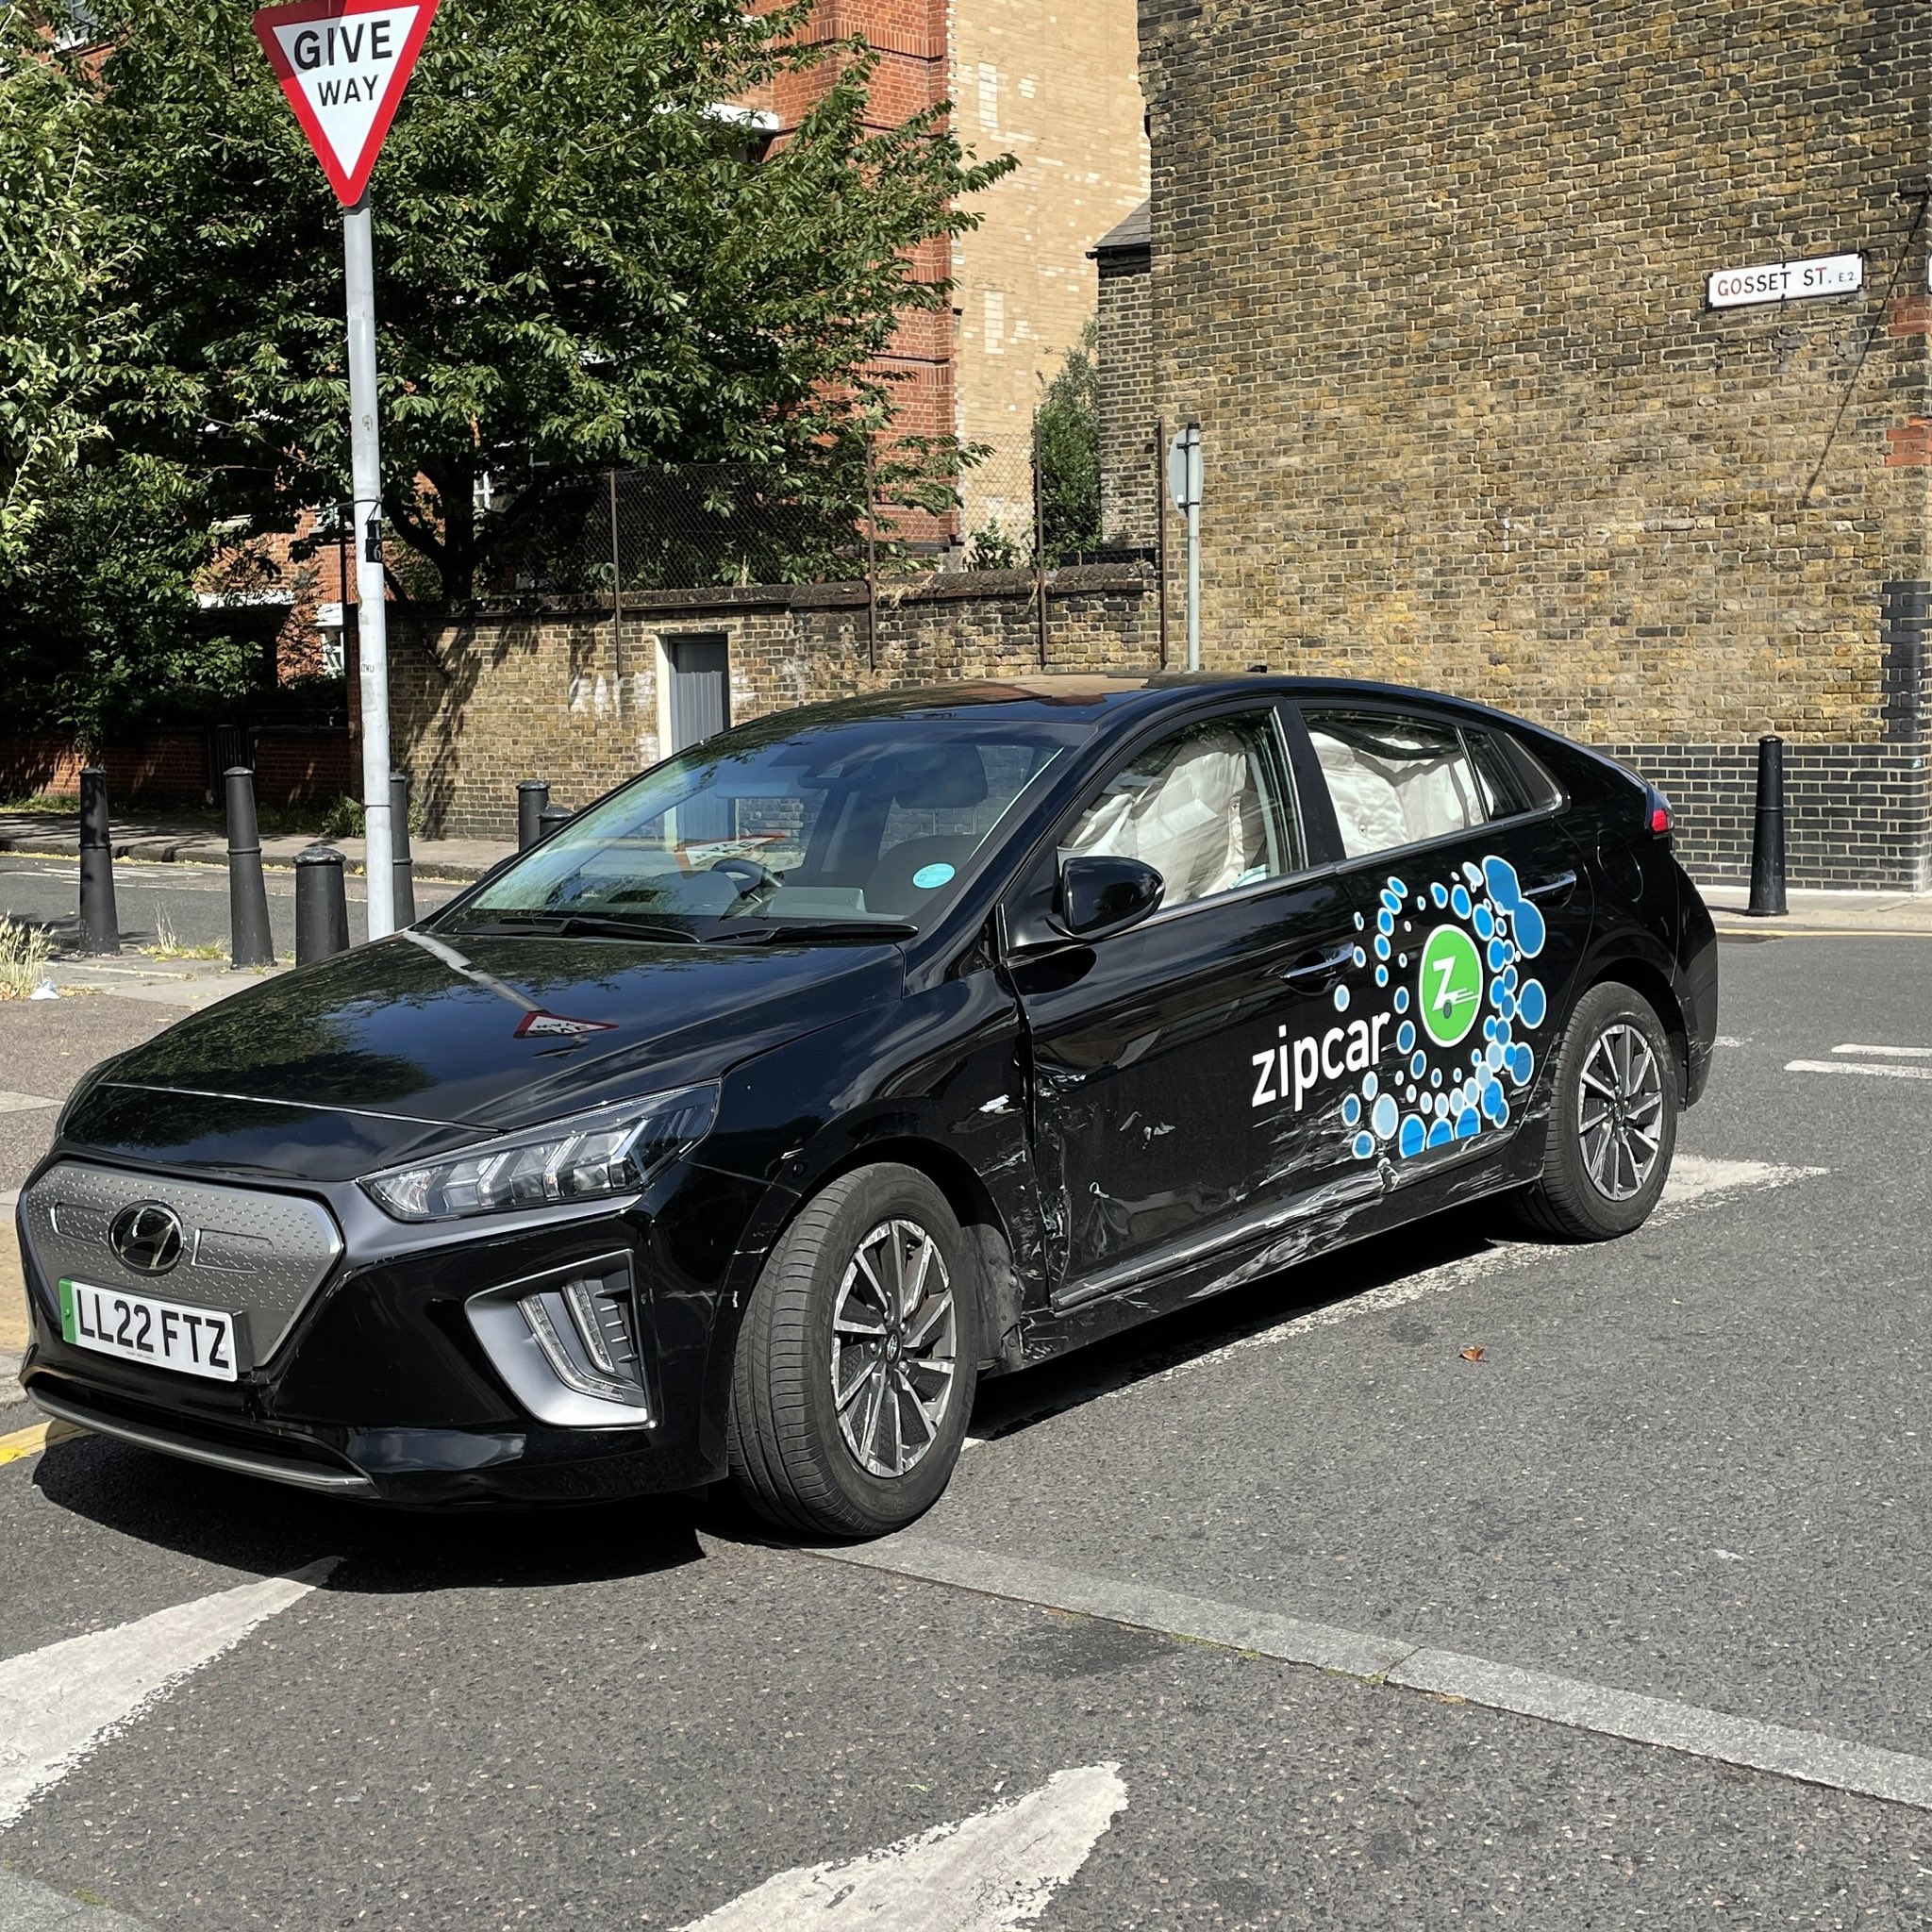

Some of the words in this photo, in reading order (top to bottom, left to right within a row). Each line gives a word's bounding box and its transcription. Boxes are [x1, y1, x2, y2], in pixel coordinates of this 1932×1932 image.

[293, 20, 392, 71] GIVE
[317, 75, 379, 107] WAY
[1717, 271, 1791, 297] GOSSET
[1803, 267, 1832, 286] ST.
[1251, 1011, 1391, 1112] zipcar
[76, 1289, 155, 1354] LL22
[160, 1308, 230, 1370] FTZ
